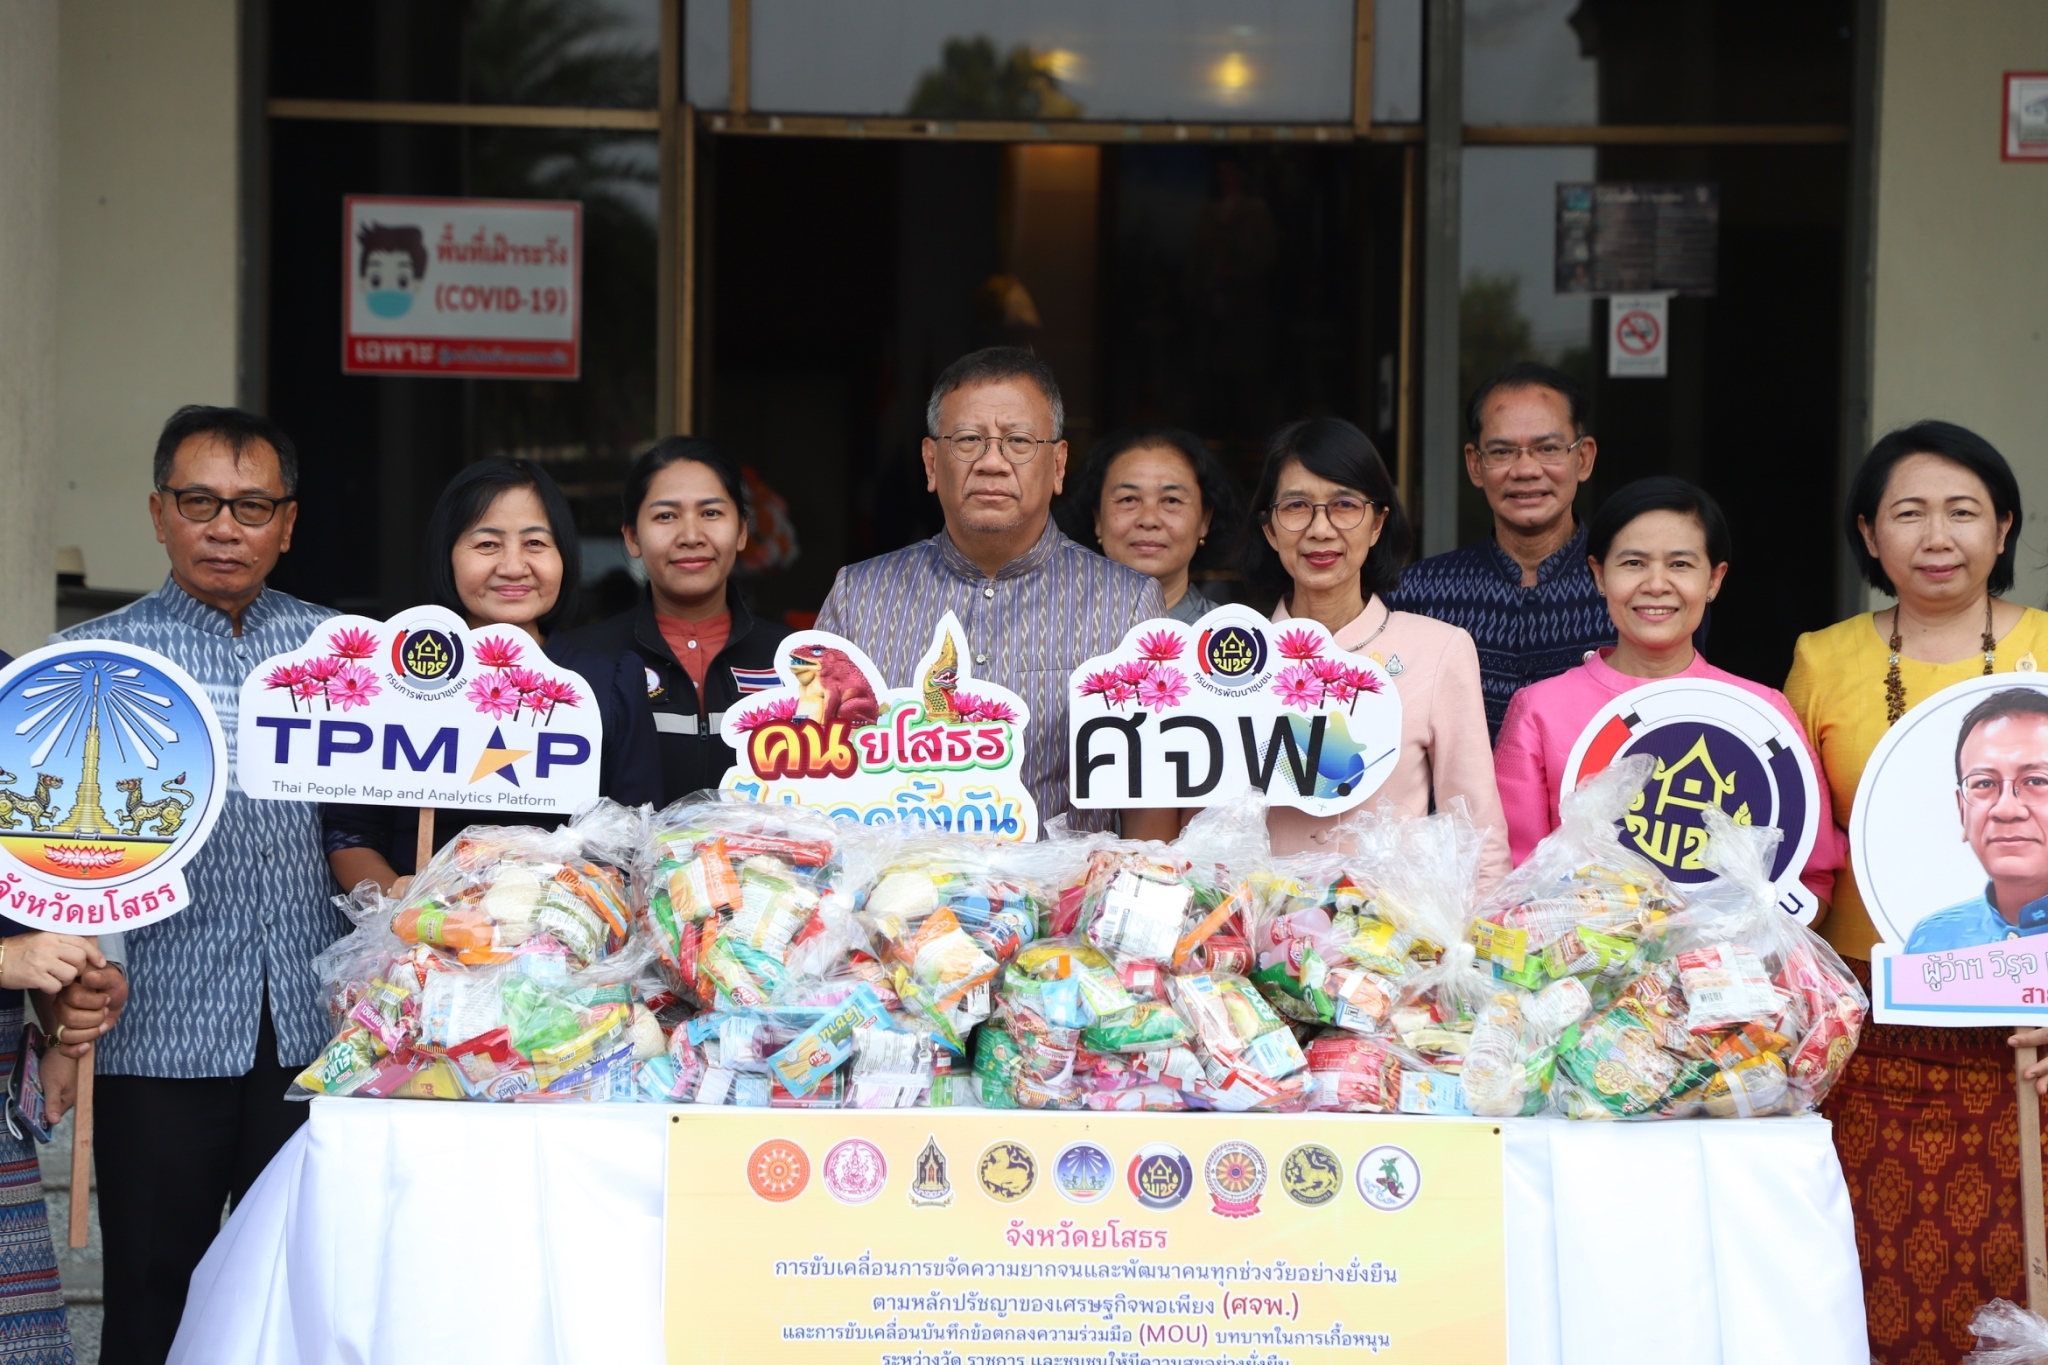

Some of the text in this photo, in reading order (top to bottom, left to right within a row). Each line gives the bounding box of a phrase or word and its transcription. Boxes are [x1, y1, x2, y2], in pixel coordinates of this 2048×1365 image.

[434, 282, 568, 315] (COVID-19)
[385, 672, 468, 701] กรมการพัฒนาชุมชน
[1193, 671, 1272, 698] กรมการพัฒนาชุมชน
[256, 716, 592, 789] TPMAP
[1076, 711, 1352, 799] ศจพ.
[272, 780, 556, 807] Thai People Map and Analytics Platform
[707, 852, 727, 902] Dewberry
[1240, 986, 1278, 1020] CAKE
[2022, 986, 2048, 1004] สา
[323, 1054, 351, 1084] EURO
[1006, 1219, 1168, 1248] จังหวัดยโสธร
[775, 1250, 1398, 1287] การขับเคลื่อนการขจัดความยากจนและพัฒนาคนทุกช่วงวัยอย่างยั่งยืน
[873, 1291, 1299, 1321] ตามหลักปรัชญาของเศรษฐกิจพอเพียง (ศจพ.)
[783, 1318, 1390, 1352] และการขับเคลื่อนบันทึกข้อตกลงความร่วมมือ (MOU) บทบาทในการเกื้อหนุน
